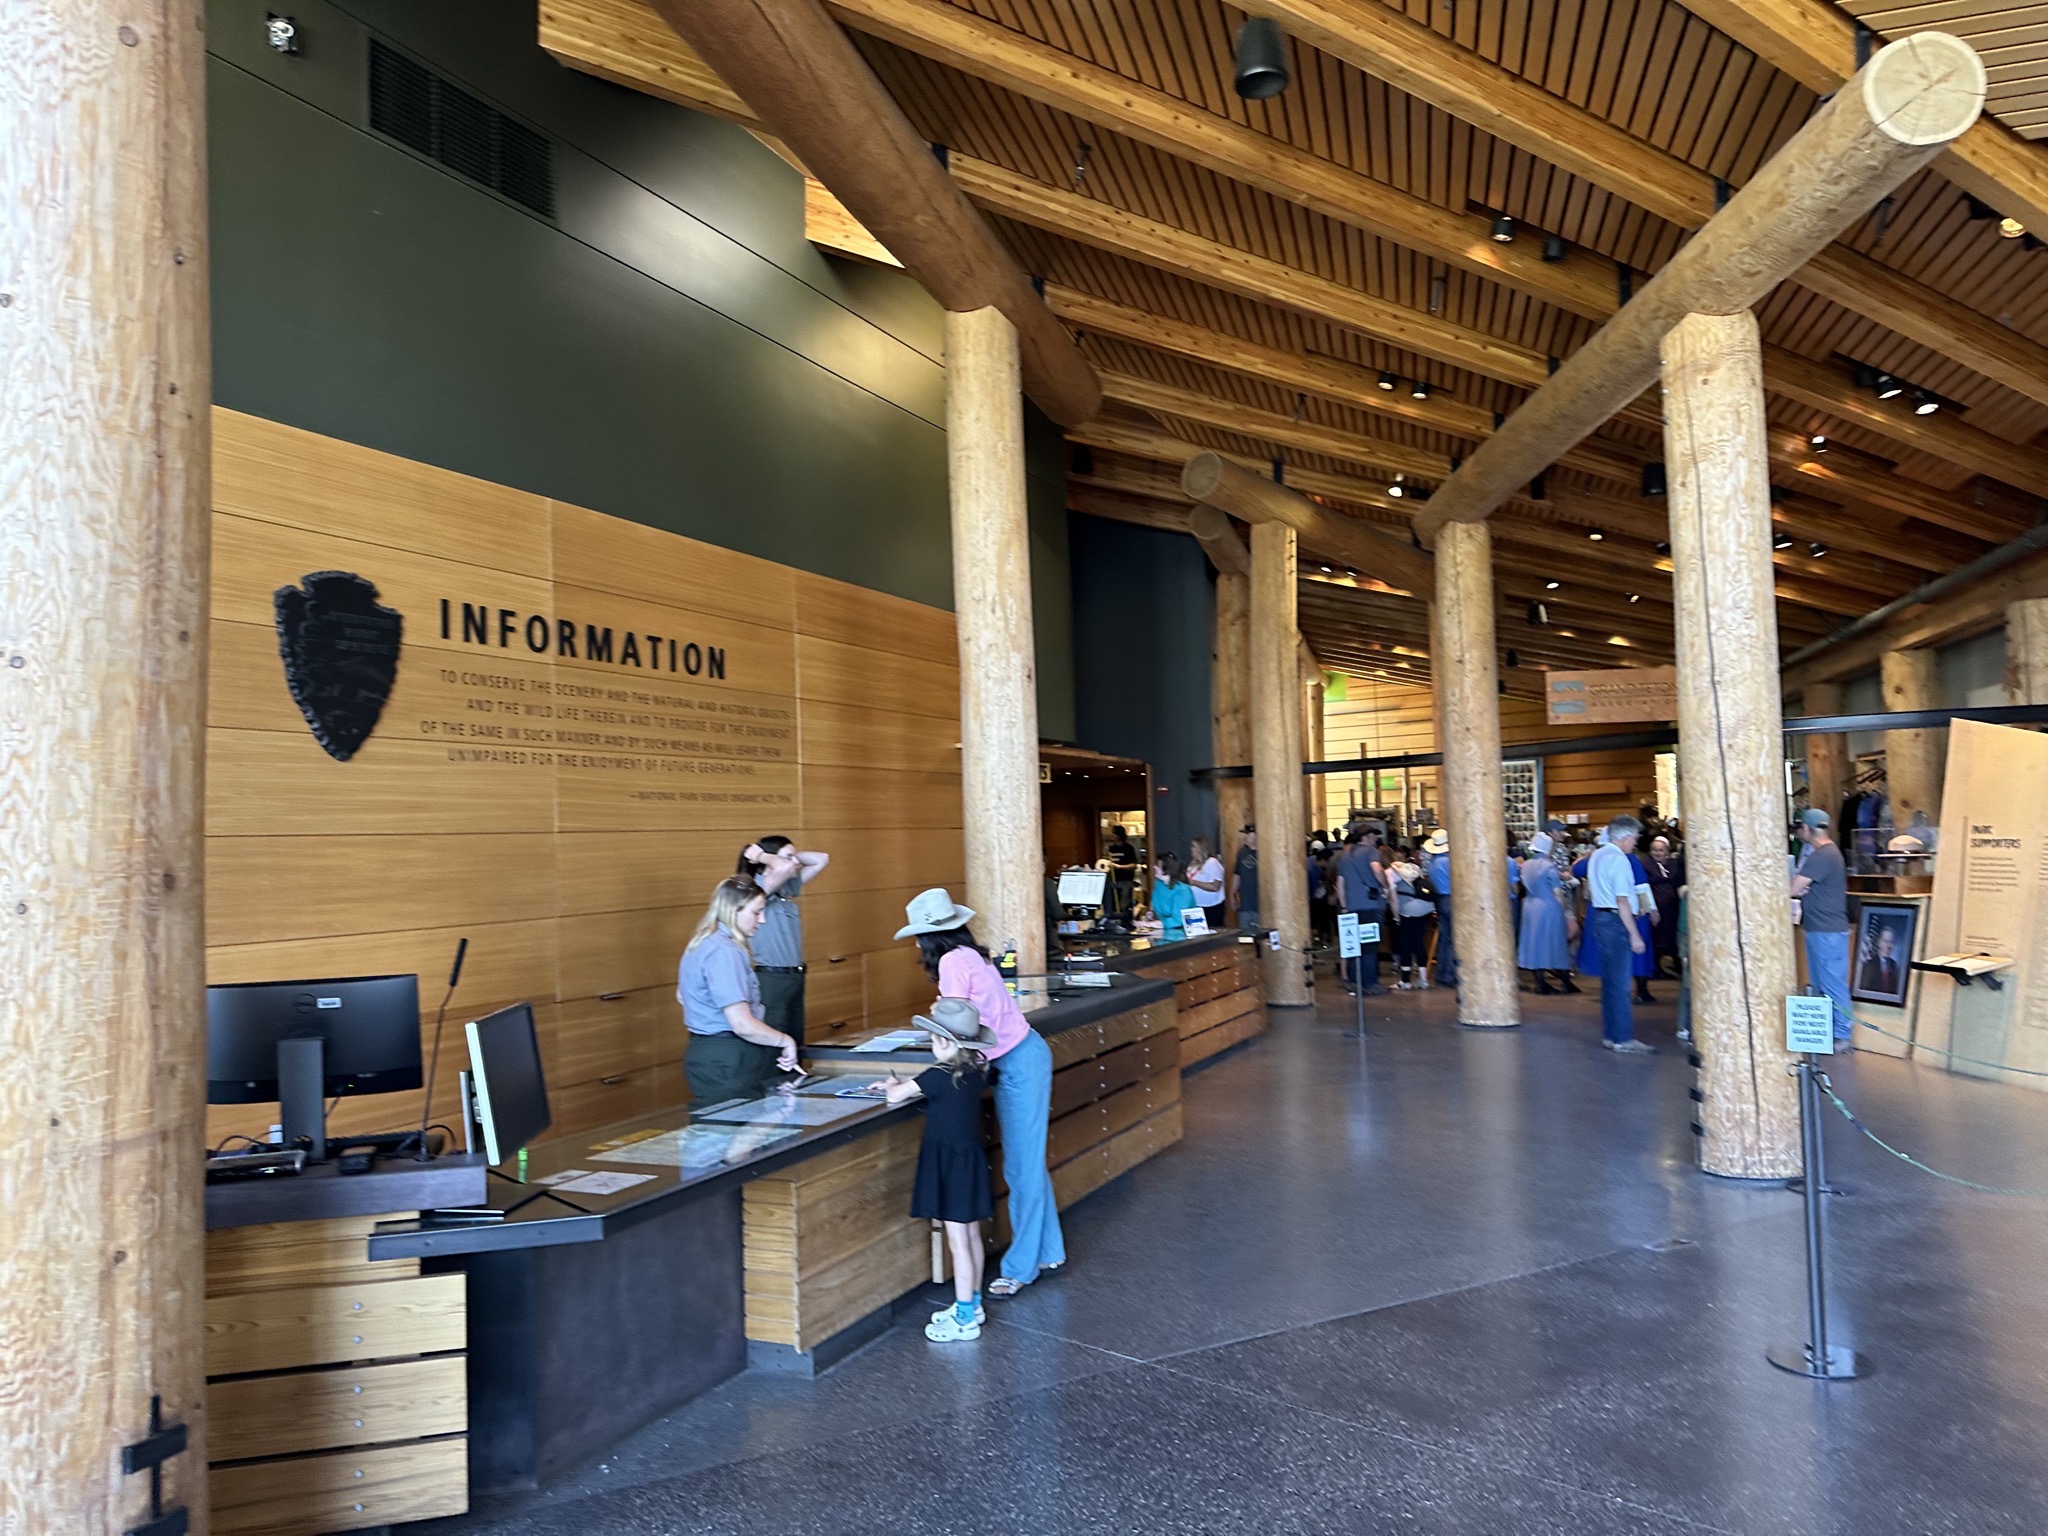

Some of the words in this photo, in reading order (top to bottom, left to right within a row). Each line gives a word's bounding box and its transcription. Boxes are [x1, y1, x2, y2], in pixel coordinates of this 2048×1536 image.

[440, 598, 726, 680] INFORMATION
[440, 669, 457, 683] TO
[461, 672, 526, 691] CONSERVE
[530, 680, 552, 694] THE
[555, 682, 603, 698] SCENERY
[607, 689, 628, 702] AND
[631, 691, 650, 705] THE
[652, 695, 696, 710] NATURAL
[698, 700, 717, 712] AND
[720, 704, 757, 717] HISTORIC
[467, 699, 493, 712] AND
[498, 701, 519, 715] THE
[524, 704, 552, 718] WILD
[557, 707, 579, 720] LIFE
[583, 709, 626, 724] THEREIN
[630, 715, 650, 727] AND
[653, 716, 666, 728] TO
[669, 717, 708, 732] PROVIDE
[709, 721, 727, 734] FOR
[728, 723, 745, 736] THE
[746, 725, 790, 739] ENJOYMENT
[420, 720, 438, 733] OF
[441, 722, 465, 736] THE
[470, 724, 503, 738] SAME
[507, 727, 520, 739] IN
[524, 728, 552, 742] SUCH
[556, 730, 600, 745] MANNER
[605, 734, 626, 747] AND
[628, 736, 640, 748] BY
[643, 737, 667, 750] SUCH
[670, 740, 700, 752] MEANS
[702, 742, 713, 754] AS
[714, 743, 735, 755] WILL
[735, 744, 759, 757] LEAVE
[760, 746, 781, 758] THEM
[448, 749, 527, 764] UNIMPAIRED
[531, 752, 552, 765] FOR
[557, 754, 577, 767] THE
[581, 755, 642, 770] ENJOYMENT
[645, 759, 659, 771] OF
[660, 760, 695, 773] FUTURE
[1970, 838, 2022, 849] SUPPORTERS
[1971, 825, 1993, 834] PARK
